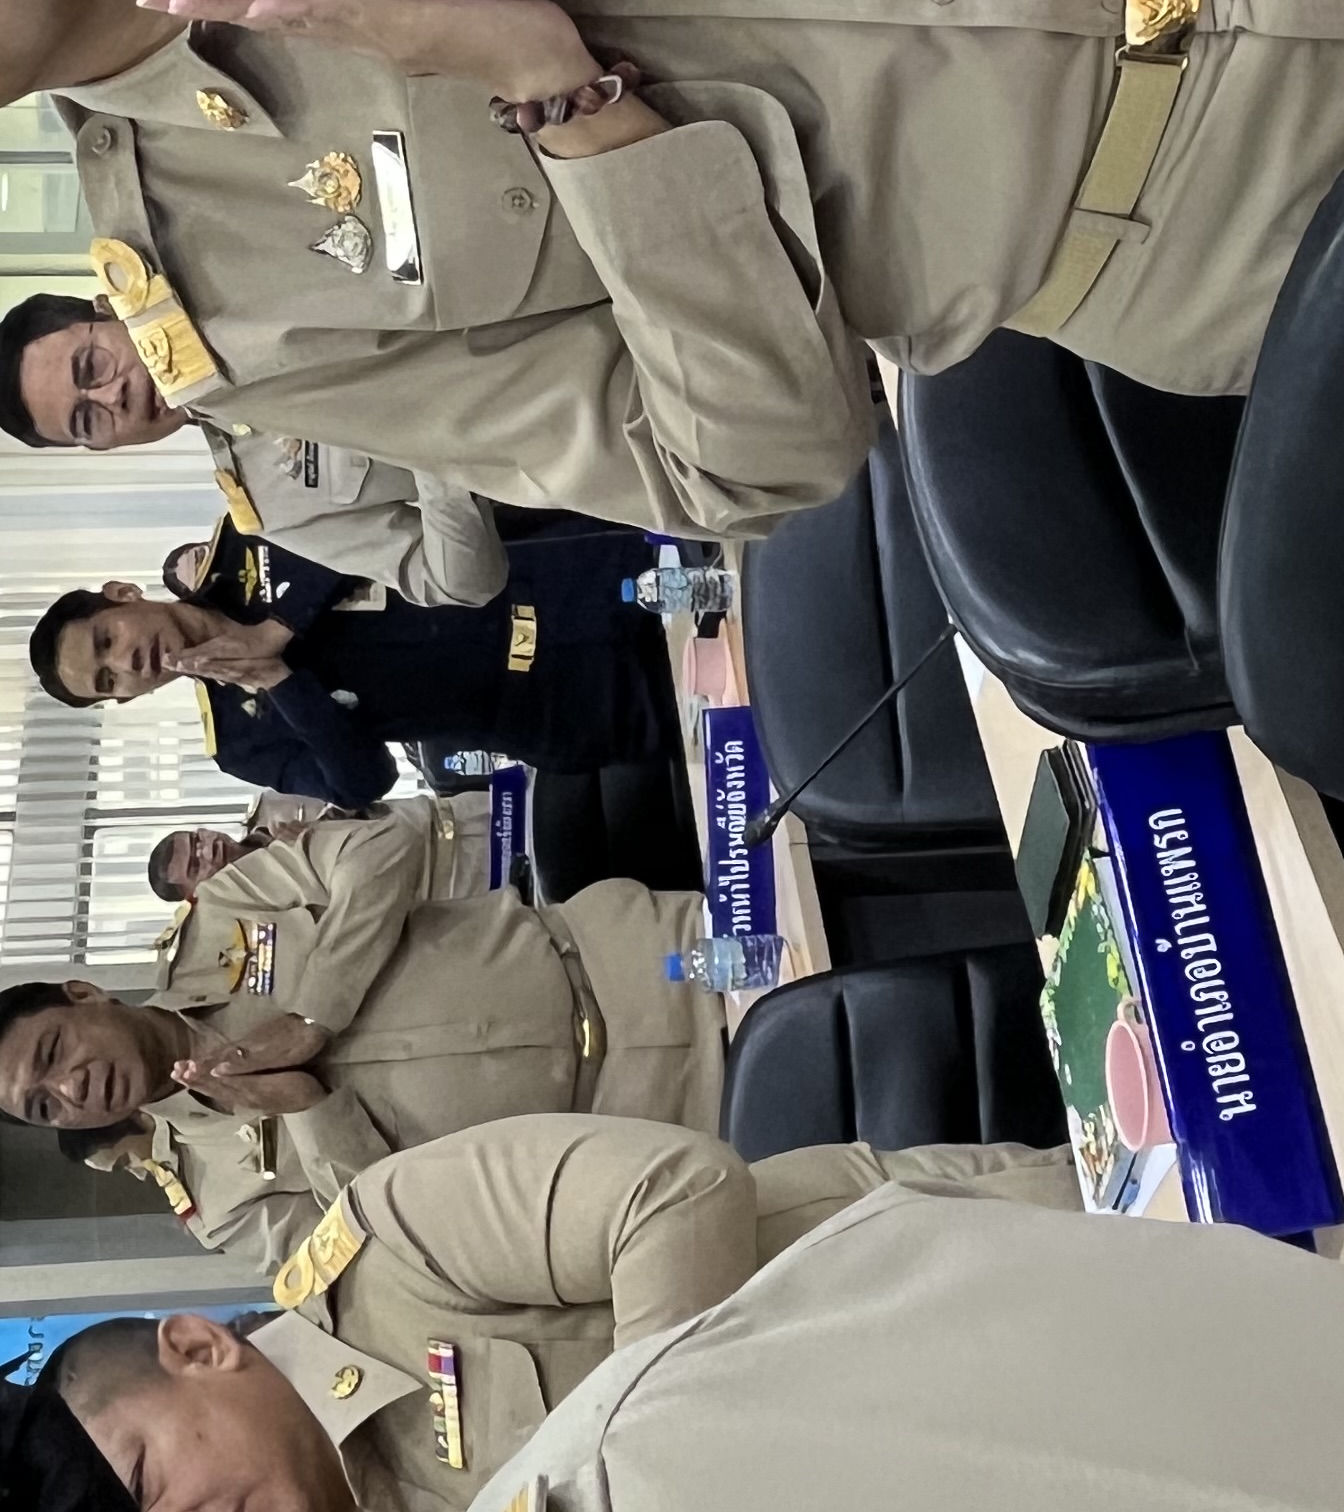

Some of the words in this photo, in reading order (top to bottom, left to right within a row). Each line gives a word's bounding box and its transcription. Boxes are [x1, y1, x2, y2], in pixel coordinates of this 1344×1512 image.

[1147, 807, 1257, 1121] นายอำเภอบ้านแพรก
